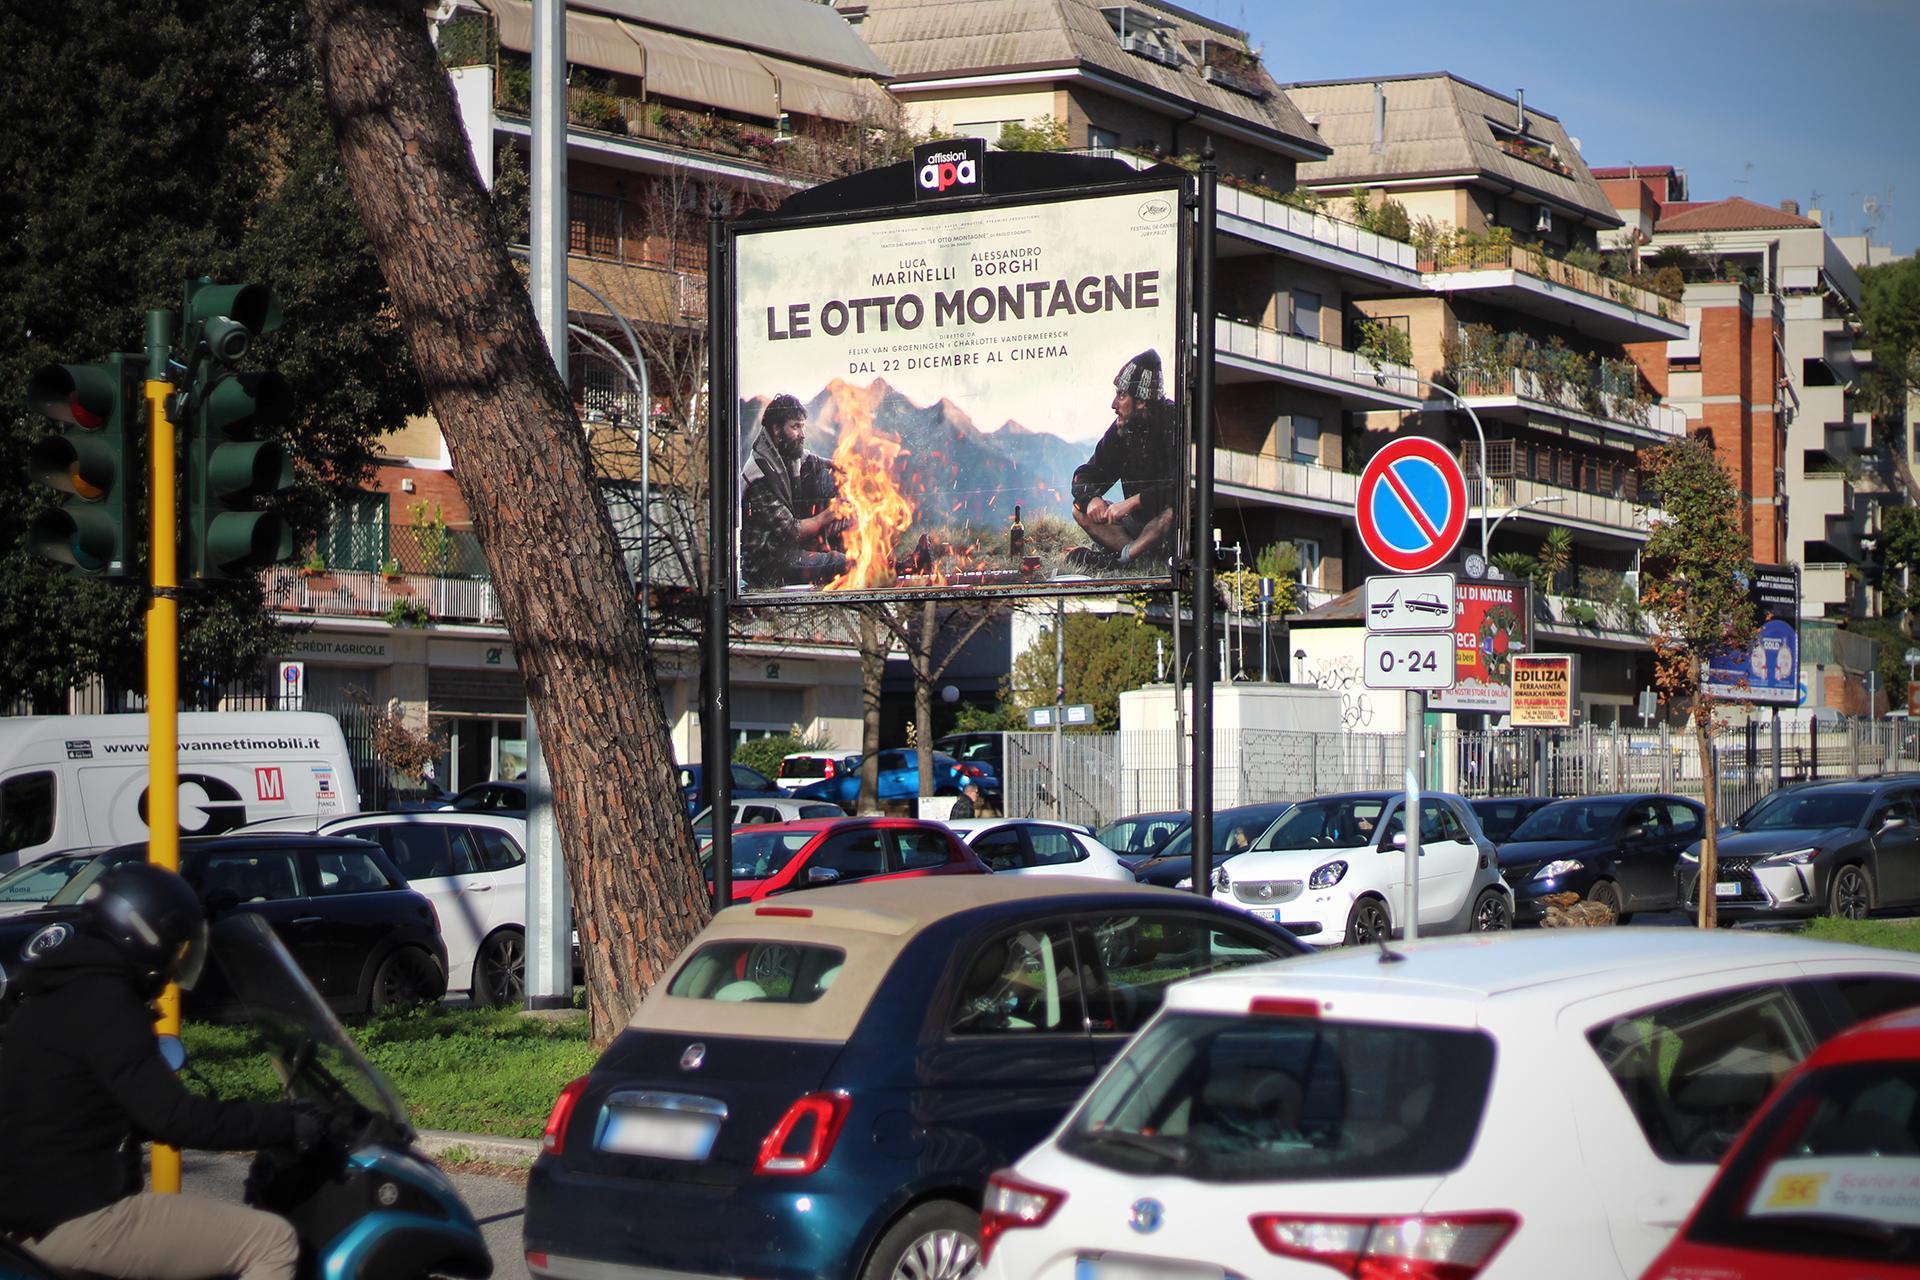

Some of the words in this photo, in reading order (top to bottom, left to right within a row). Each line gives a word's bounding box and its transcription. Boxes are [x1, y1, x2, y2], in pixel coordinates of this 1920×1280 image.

[928, 150, 967, 164] affissioni
[920, 160, 976, 192] apa
[971, 247, 1042, 262] ALESSANDRO
[900, 259, 927, 269] LUCA
[975, 258, 1038, 277] BORGHI
[872, 267, 955, 286] MARINELLI
[767, 303, 811, 341] LE
[821, 294, 924, 336] OTTO
[935, 271, 1159, 327] MONTAGNE
[849, 347, 869, 355] FELIX
[892, 342, 945, 352] GROENINGEN
[954, 337, 997, 347] CHARLOTTE
[1001, 331, 1069, 343] VANDERMEERSCH
[850, 362, 875, 374] DAL
[884, 360, 900, 371] 22
[908, 353, 979, 370] DICEMBRE
[987, 351, 1003, 363] AL
[1011, 345, 1068, 361] CINEMA
[1457, 586, 1467, 600] ALI
[1469, 587, 1478, 600] DI
[1480, 589, 1512, 603] NATALE
[296, 641, 332, 653] CRÉDIT
[335, 644, 385, 655] AGRICOLE
[1456, 632, 1476, 648] eca
[1515, 671, 1567, 682] EDILIZIA
[104, 738, 320, 753] wwwvannettimobili.it
